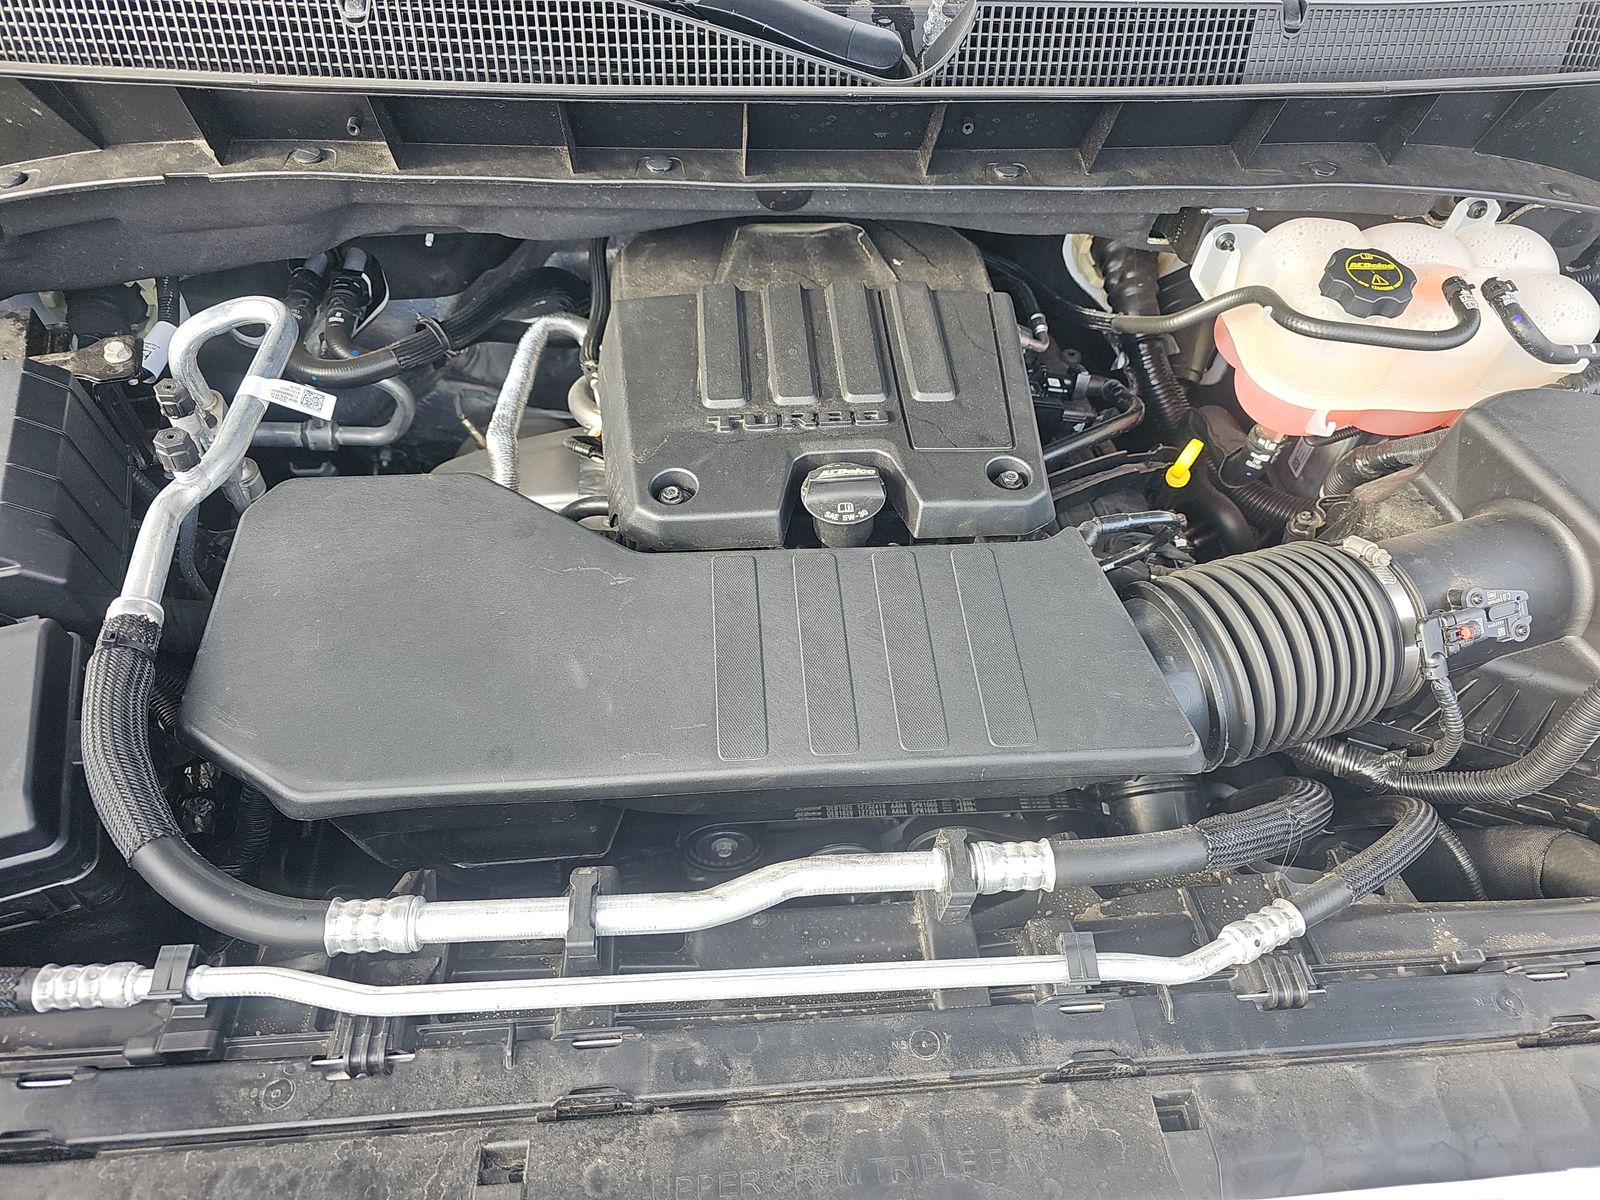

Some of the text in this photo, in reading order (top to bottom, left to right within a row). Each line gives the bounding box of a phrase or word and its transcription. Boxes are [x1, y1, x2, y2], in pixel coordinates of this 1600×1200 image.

[706, 410, 891, 432] TURBO
[824, 509, 869, 521] SAE 5W-30
[869, 1150, 976, 1183] TRIPLE
[987, 1148, 1047, 1175] FAN
